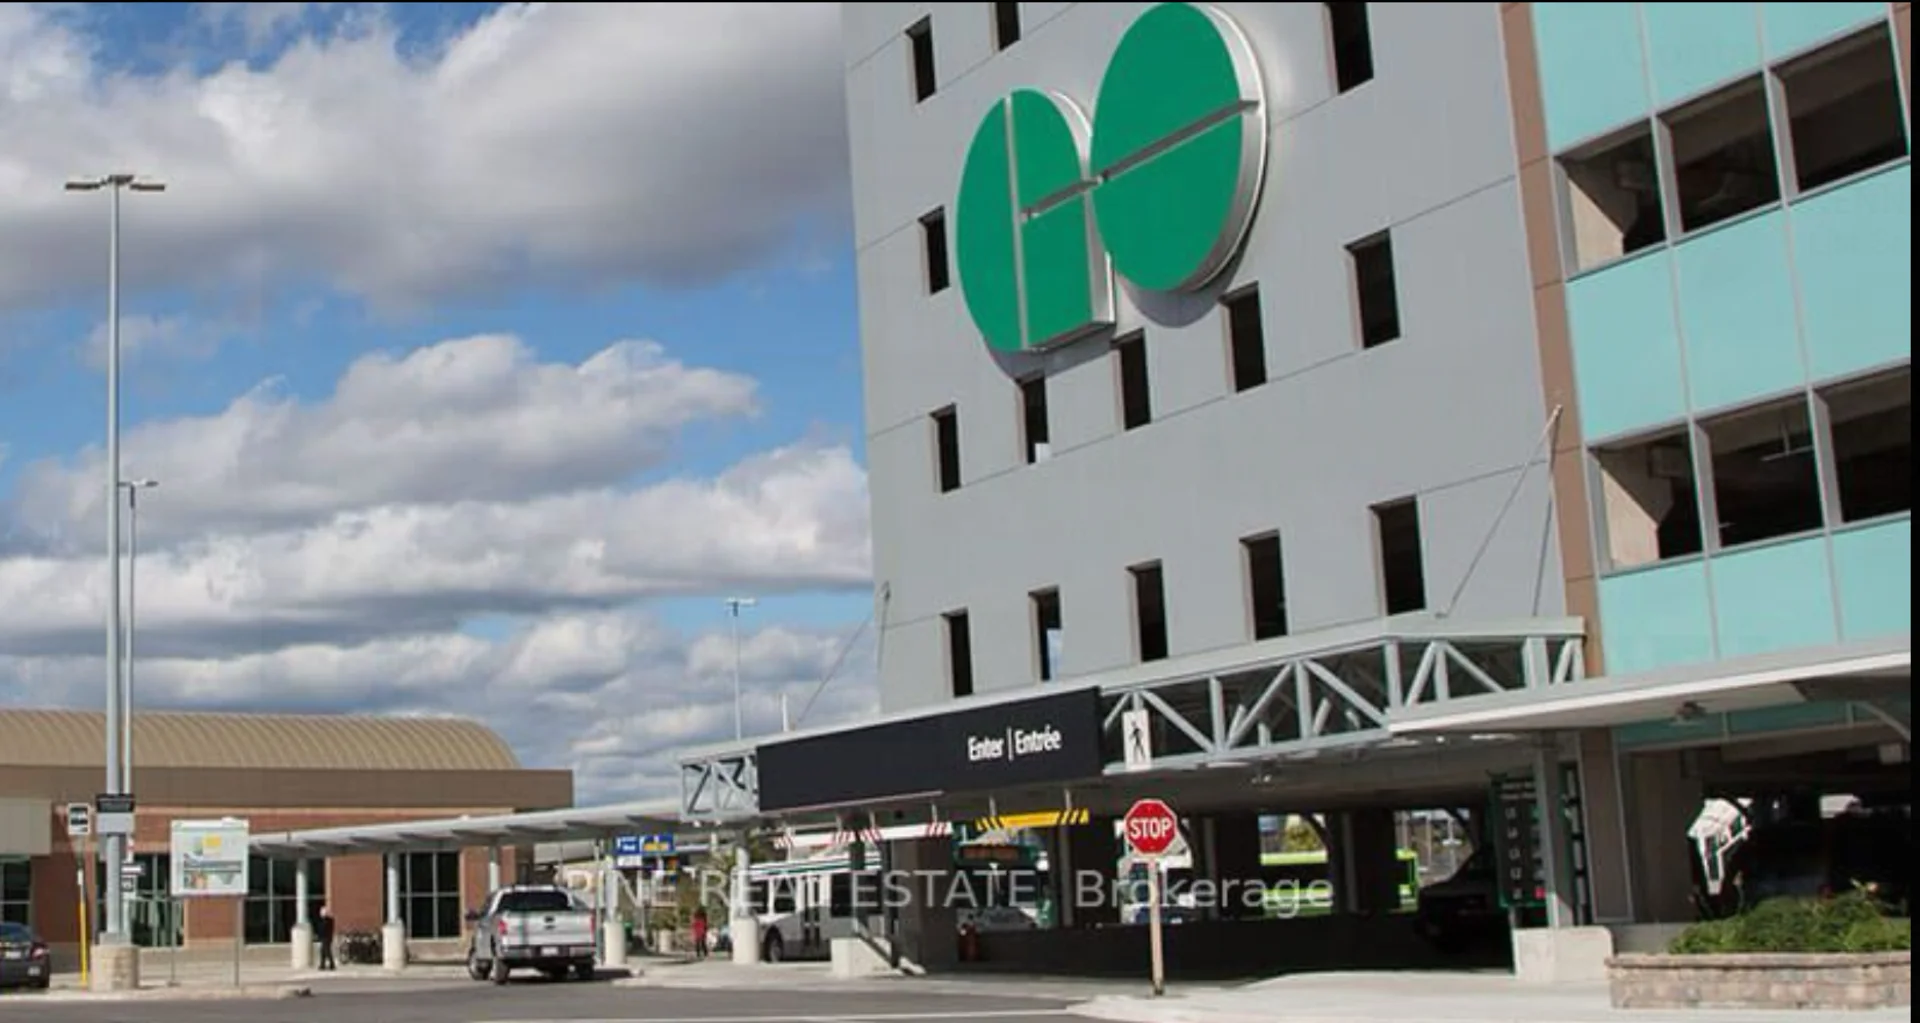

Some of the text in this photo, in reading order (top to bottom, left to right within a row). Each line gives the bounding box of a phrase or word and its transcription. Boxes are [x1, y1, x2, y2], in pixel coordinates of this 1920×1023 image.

[967, 723, 1062, 761] Enter Entrée
[1130, 817, 1171, 839] STOP
